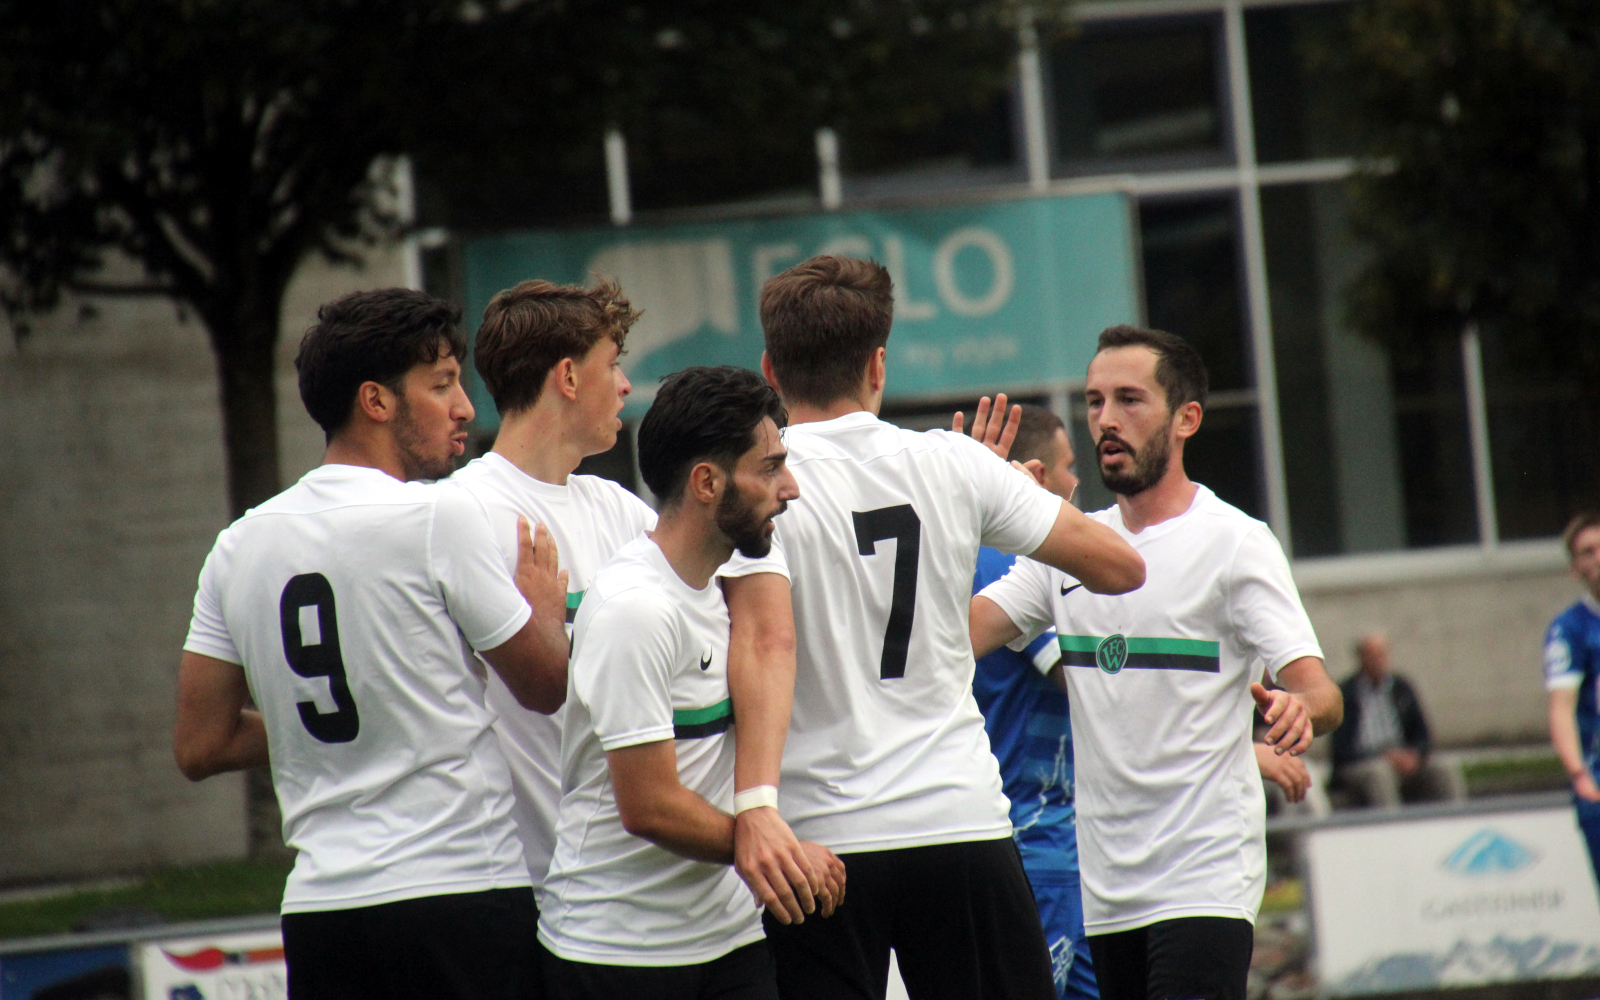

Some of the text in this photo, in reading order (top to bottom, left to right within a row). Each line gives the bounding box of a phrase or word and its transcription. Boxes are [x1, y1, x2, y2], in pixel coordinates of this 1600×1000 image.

[754, 228, 1014, 322] LO
[280, 572, 359, 743] 9
[852, 504, 921, 680] 7
